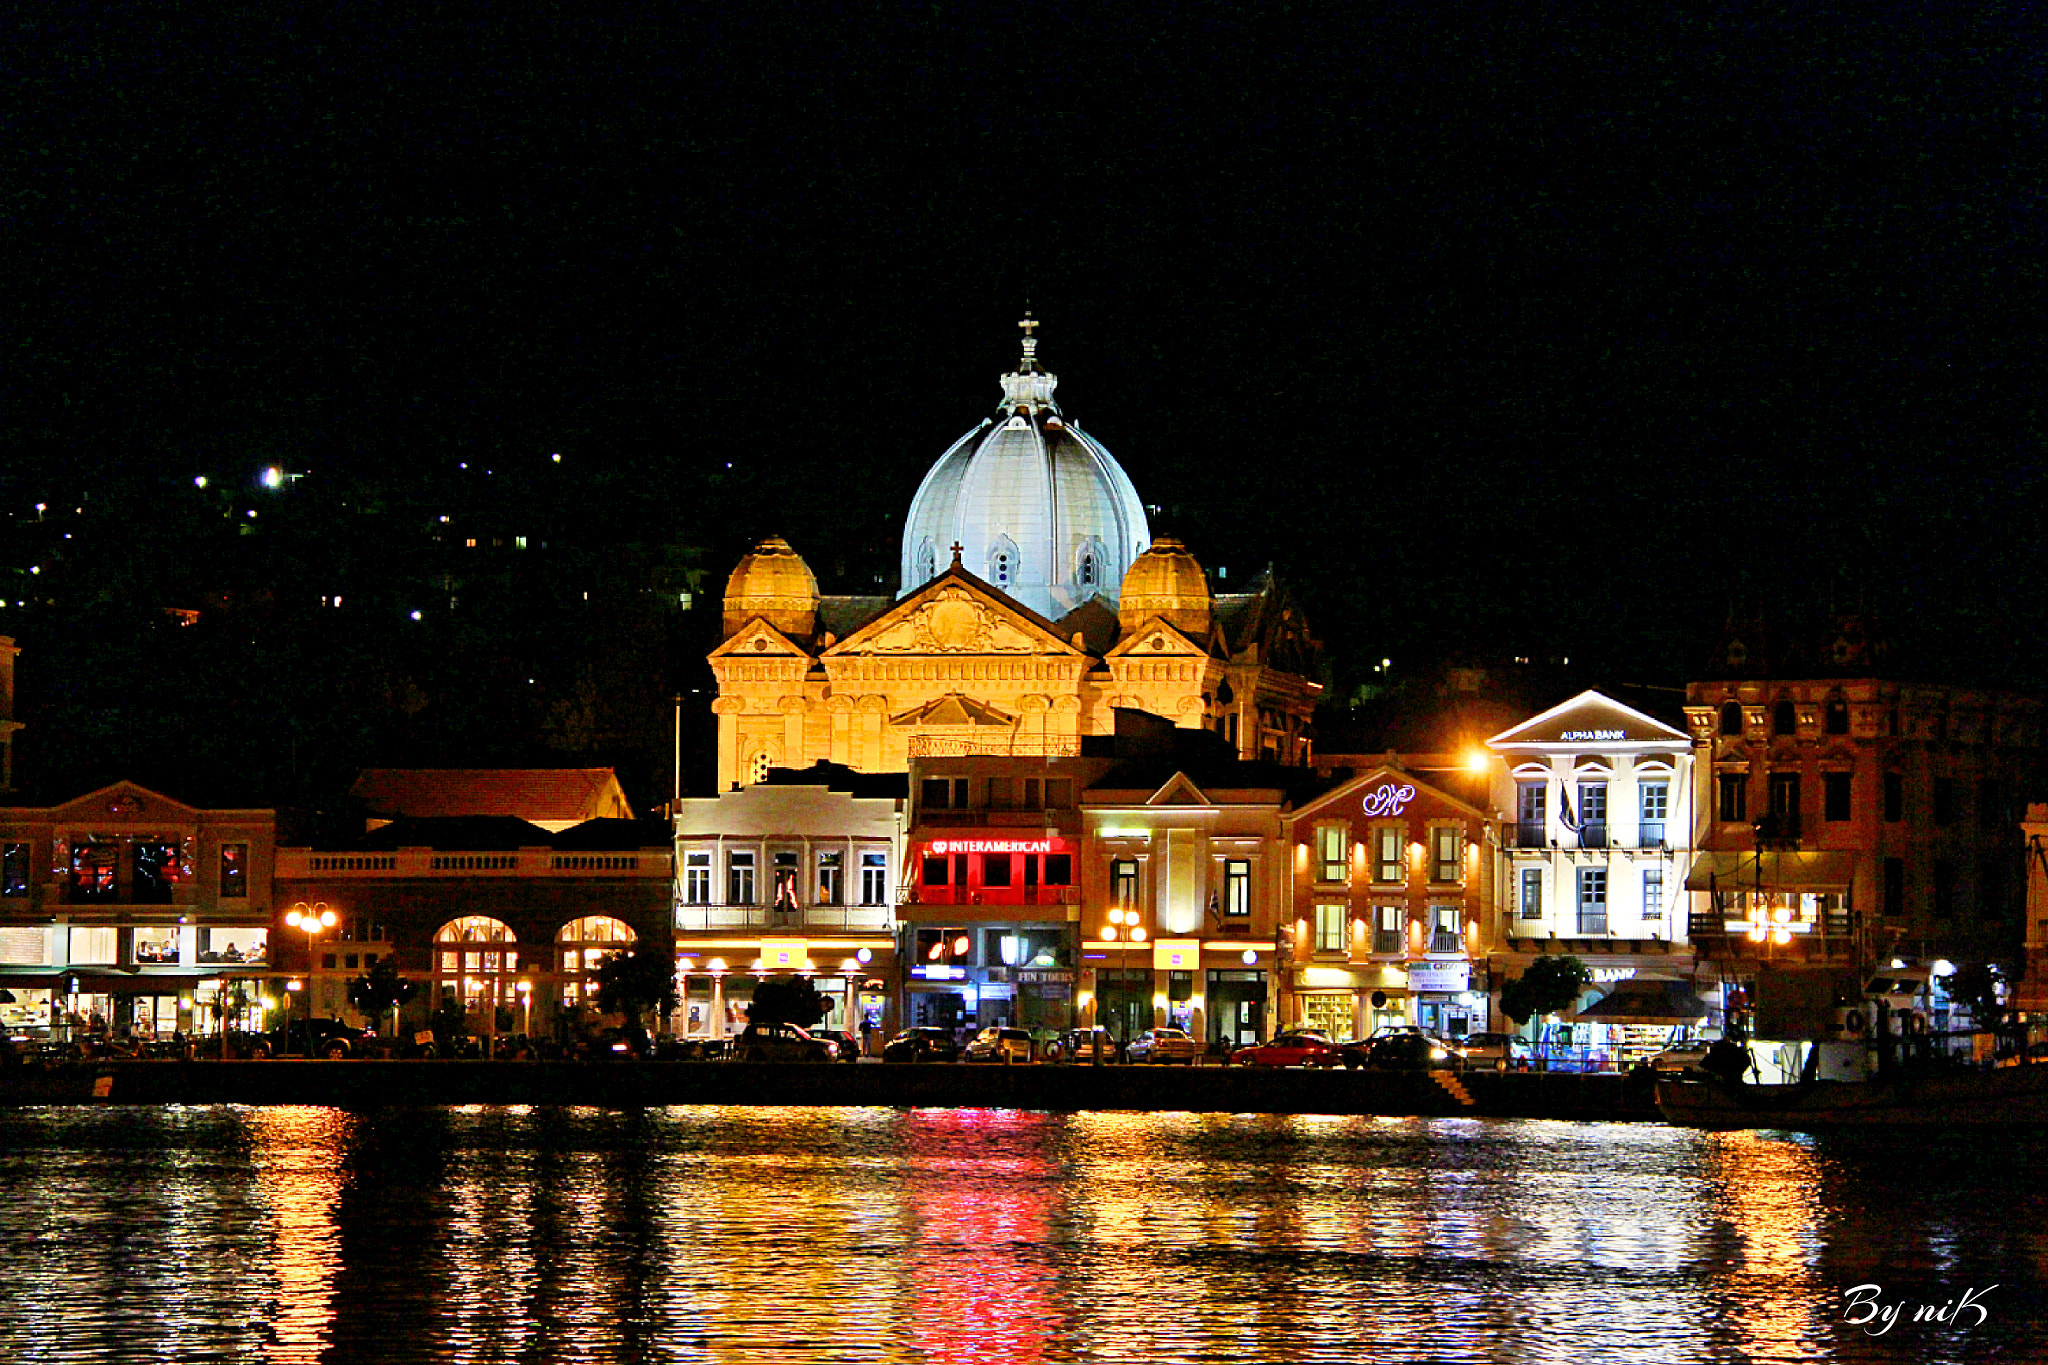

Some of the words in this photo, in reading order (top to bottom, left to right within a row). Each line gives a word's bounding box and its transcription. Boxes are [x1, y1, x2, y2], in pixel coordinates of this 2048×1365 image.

[1561, 731, 1594, 740] ALPHA
[1595, 730, 1625, 740] BANK
[949, 841, 1050, 852] INTERAMERICAN
